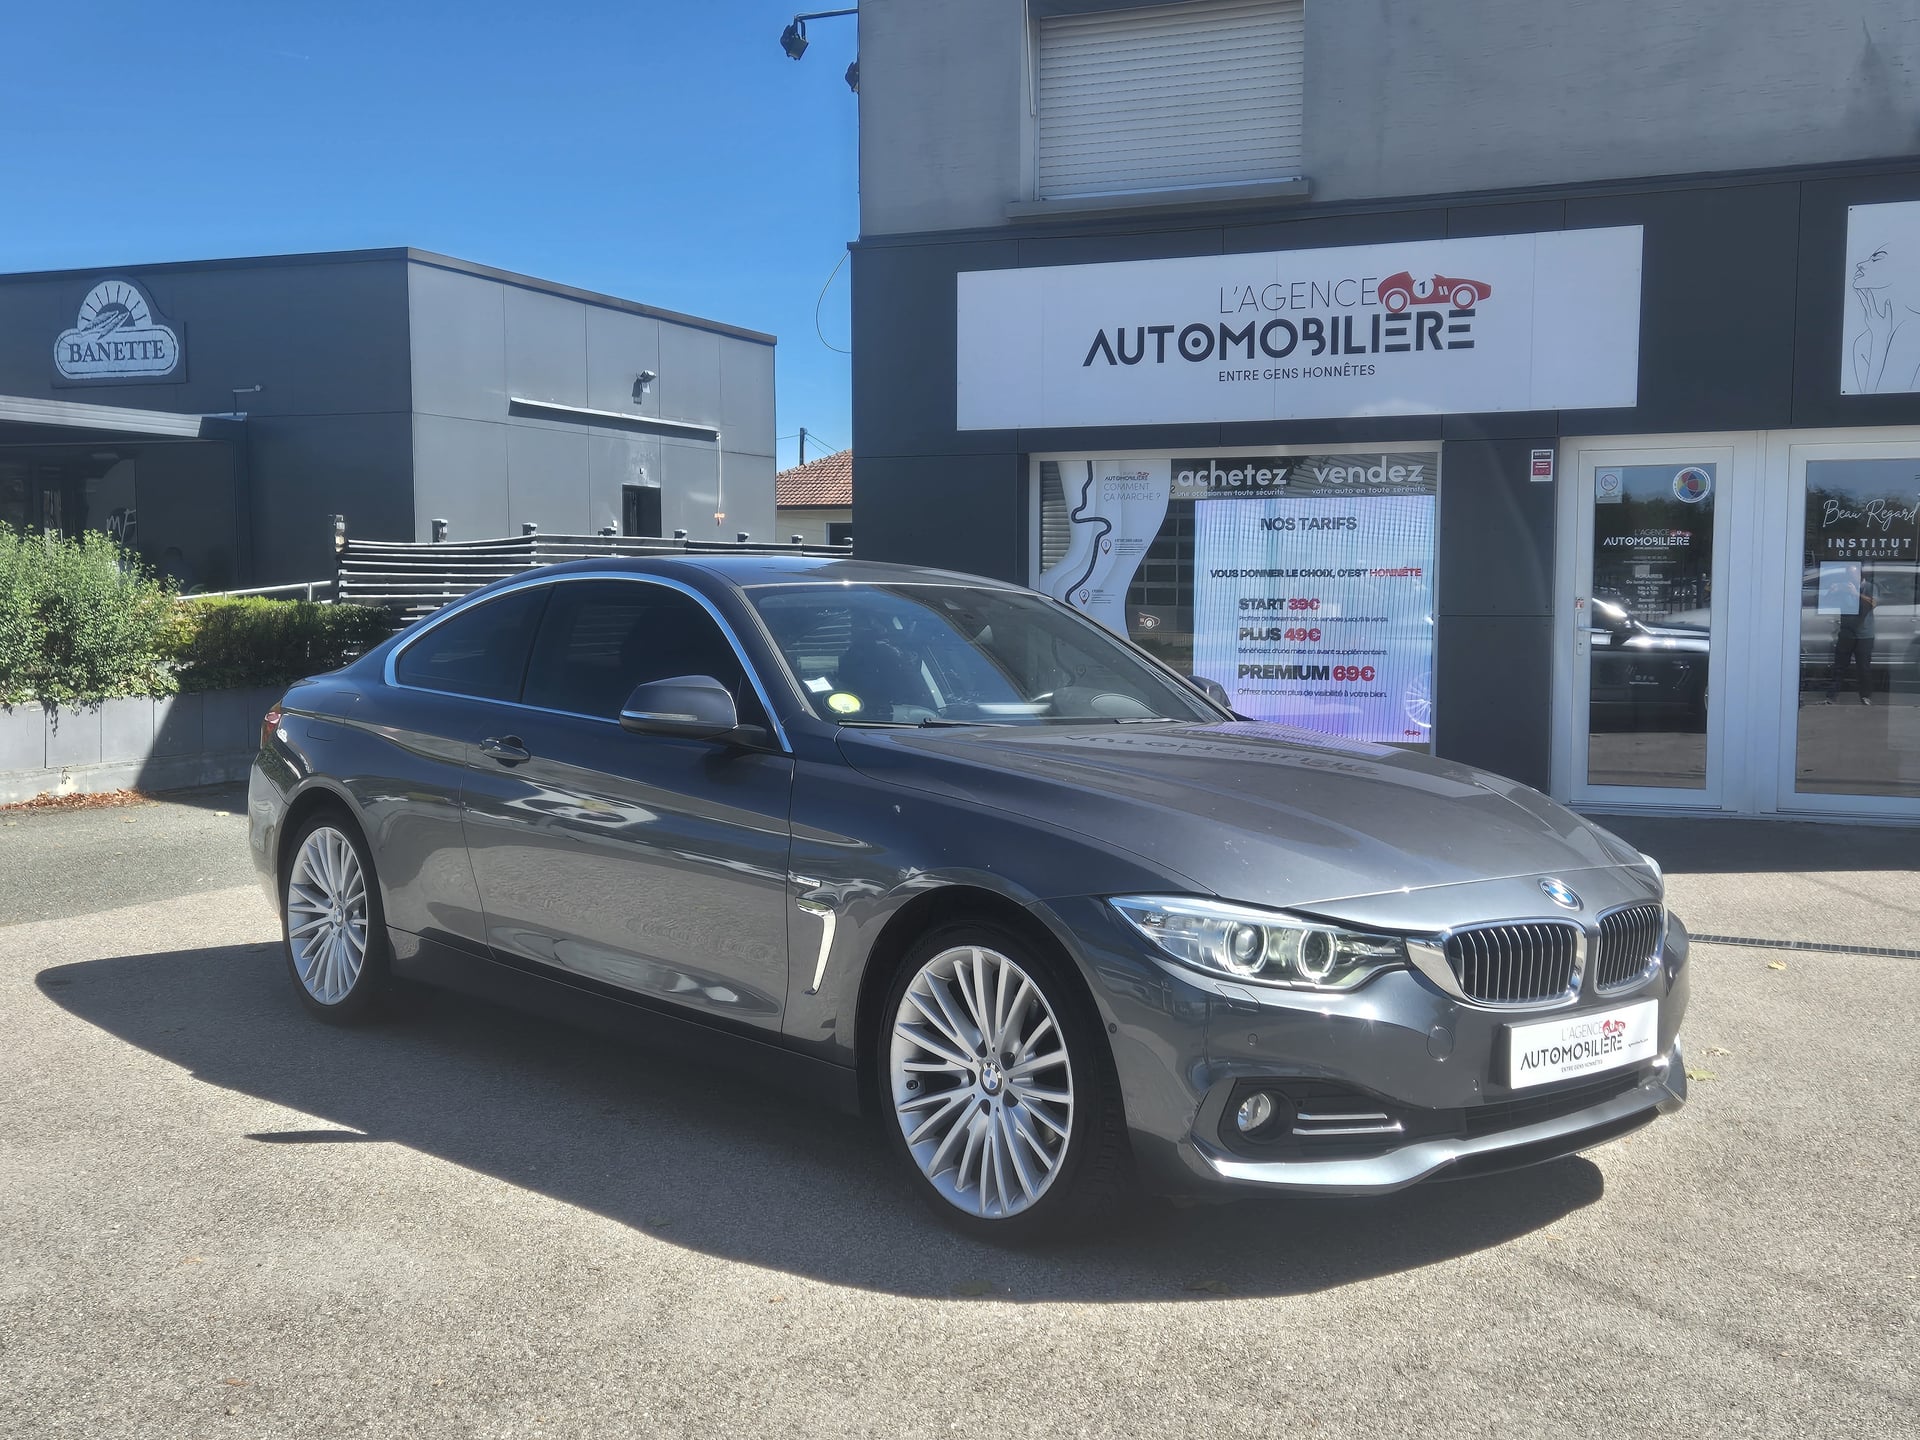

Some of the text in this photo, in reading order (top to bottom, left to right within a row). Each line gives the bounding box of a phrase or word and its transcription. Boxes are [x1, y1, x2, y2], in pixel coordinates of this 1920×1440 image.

[1220, 277, 1378, 314] L'AGENCE
[68, 340, 166, 363] BANETTE
[1218, 362, 1376, 382] ENTRE GENS HONNÊTES
[1177, 455, 1424, 487] achetez vendez
[1103, 482, 1150, 491] COMMENT
[1191, 488, 1222, 497] occasion
[1118, 492, 1154, 501] MARCHE
[1822, 498, 1920, 531] Beau Regard
[1260, 516, 1358, 531] NOS TARIFS
[1828, 538, 1912, 548] INSTITUT
[1838, 549, 1852, 557] DE
[1210, 568, 1239, 579] VOUS
[1240, 568, 1284, 578] DONNER
[1286, 568, 1299, 578] LE
[1238, 597, 1286, 611] START
[1238, 627, 1322, 642] PLUS 49€
[1237, 663, 1376, 682] PREMIUM 69€
